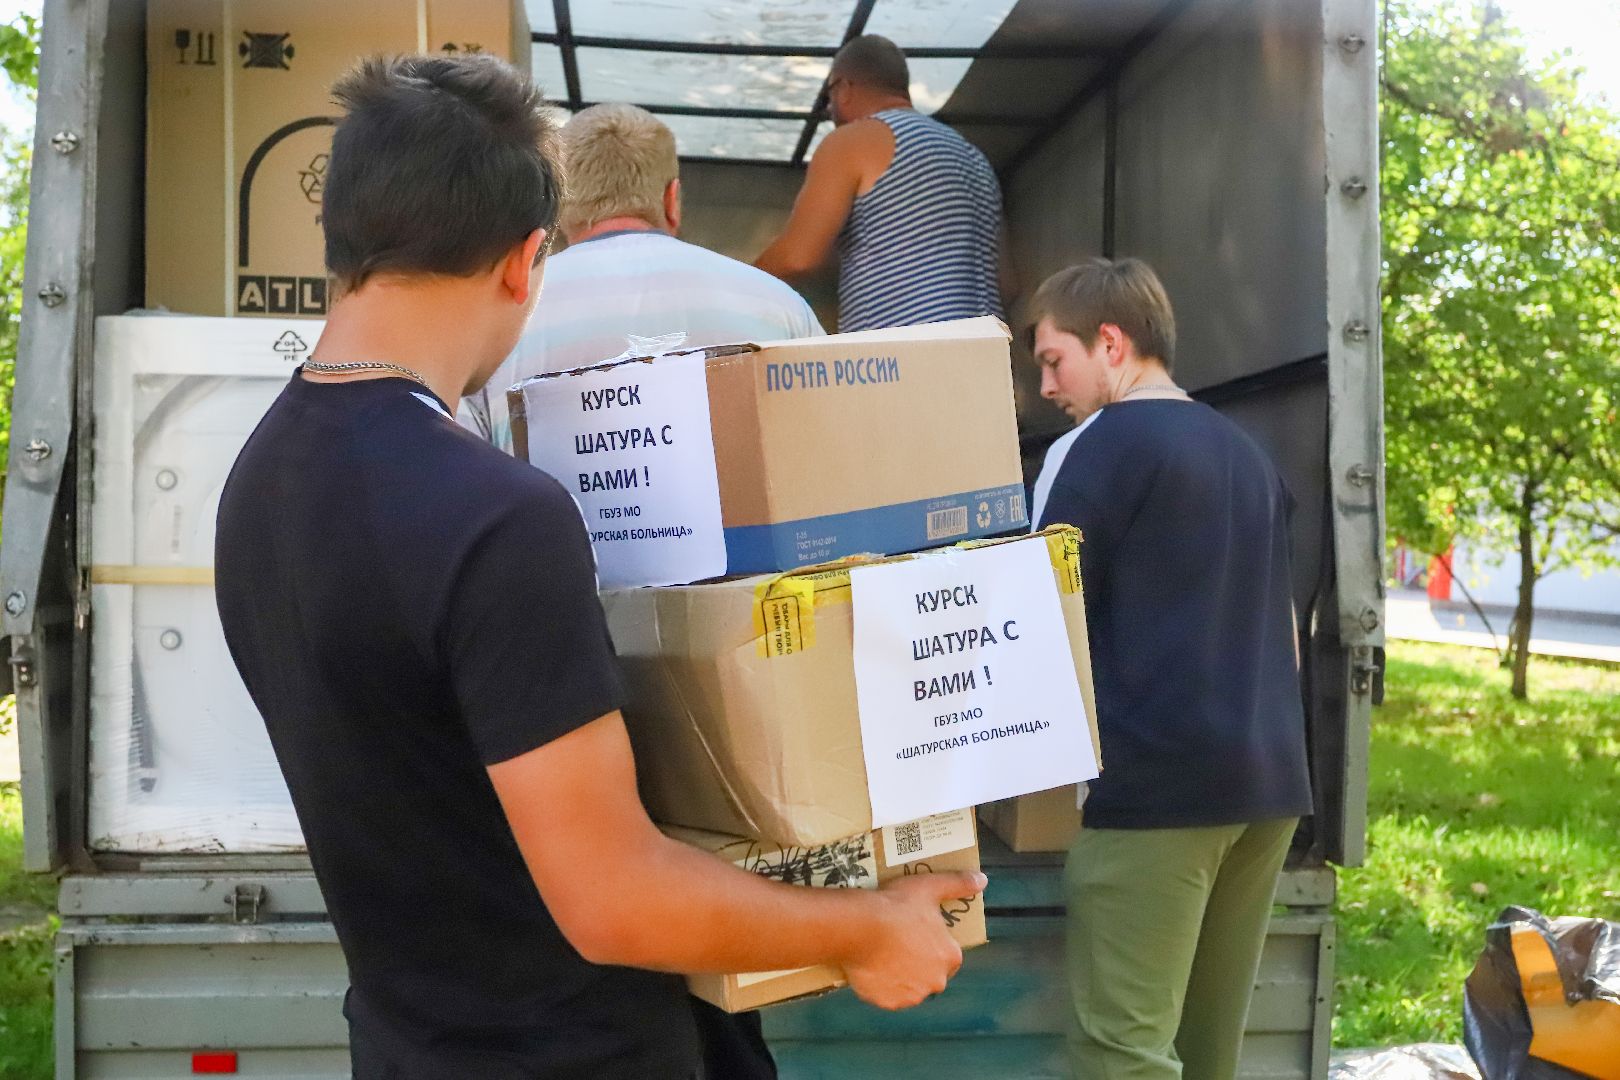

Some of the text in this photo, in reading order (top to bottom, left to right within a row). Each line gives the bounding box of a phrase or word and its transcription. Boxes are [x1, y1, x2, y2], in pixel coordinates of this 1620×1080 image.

[239, 280, 324, 310] ATL
[767, 356, 900, 391] ПОЧТА РОССИИ
[581, 384, 641, 412] КУРСК
[575, 424, 673, 454] ШАТУРА С
[579, 467, 638, 492] ВАМИ
[600, 506, 641, 519] ГБУЗ МО
[590, 525, 693, 542] УРСКАЯ БОЛЬНИЦА»
[915, 584, 978, 614] КУРСК
[912, 620, 1020, 661] ШАТУРА С
[913, 669, 976, 701] ВАМИ
[934, 707, 983, 727] ГБУЗ МО
[896, 719, 1050, 760] «ШАТУРСКАЯ БОЛЬНИЦА»
